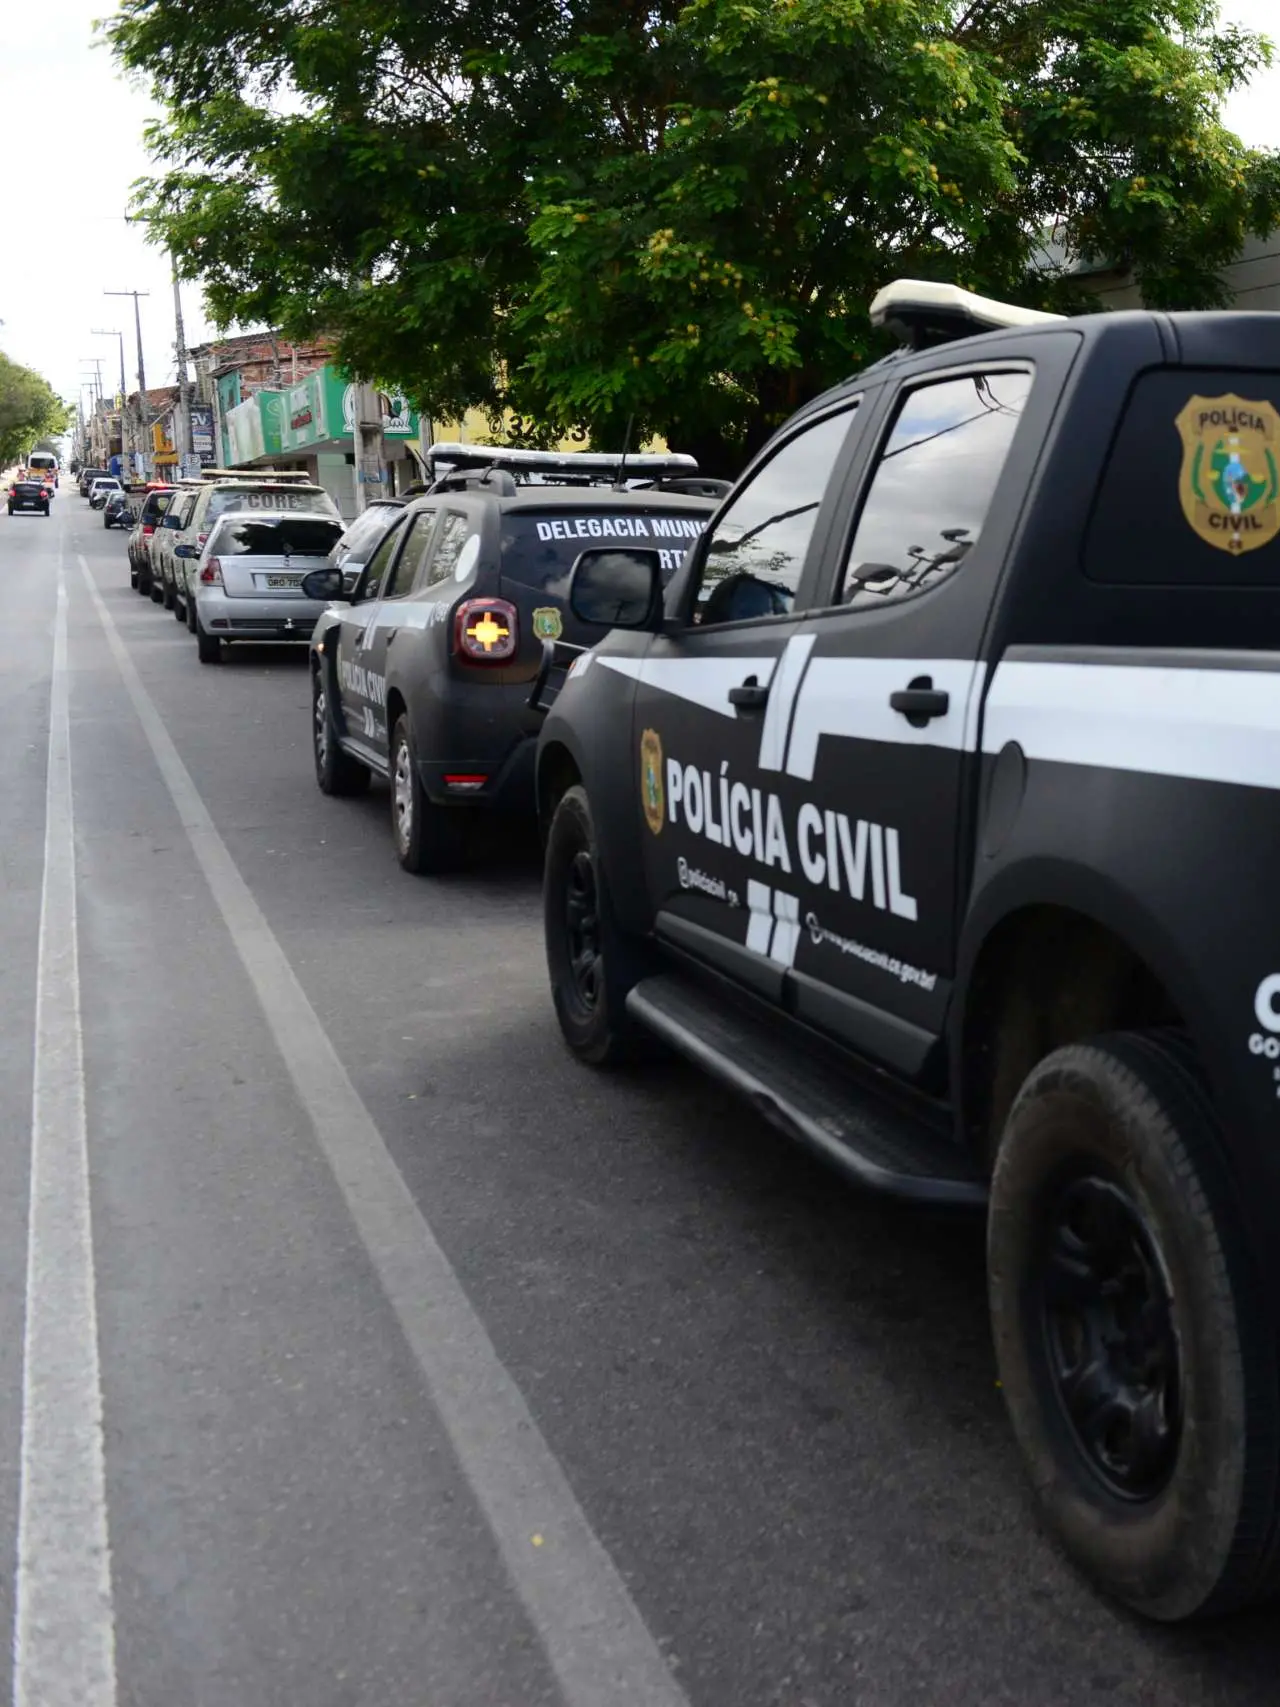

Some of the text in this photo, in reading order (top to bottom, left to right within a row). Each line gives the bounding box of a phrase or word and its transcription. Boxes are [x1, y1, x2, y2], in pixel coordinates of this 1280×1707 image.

[536, 519, 649, 541] DELEGACIA
[1208, 513, 1263, 531] CIVIL
[667, 758, 917, 921] POLÍCIA CIVIL
